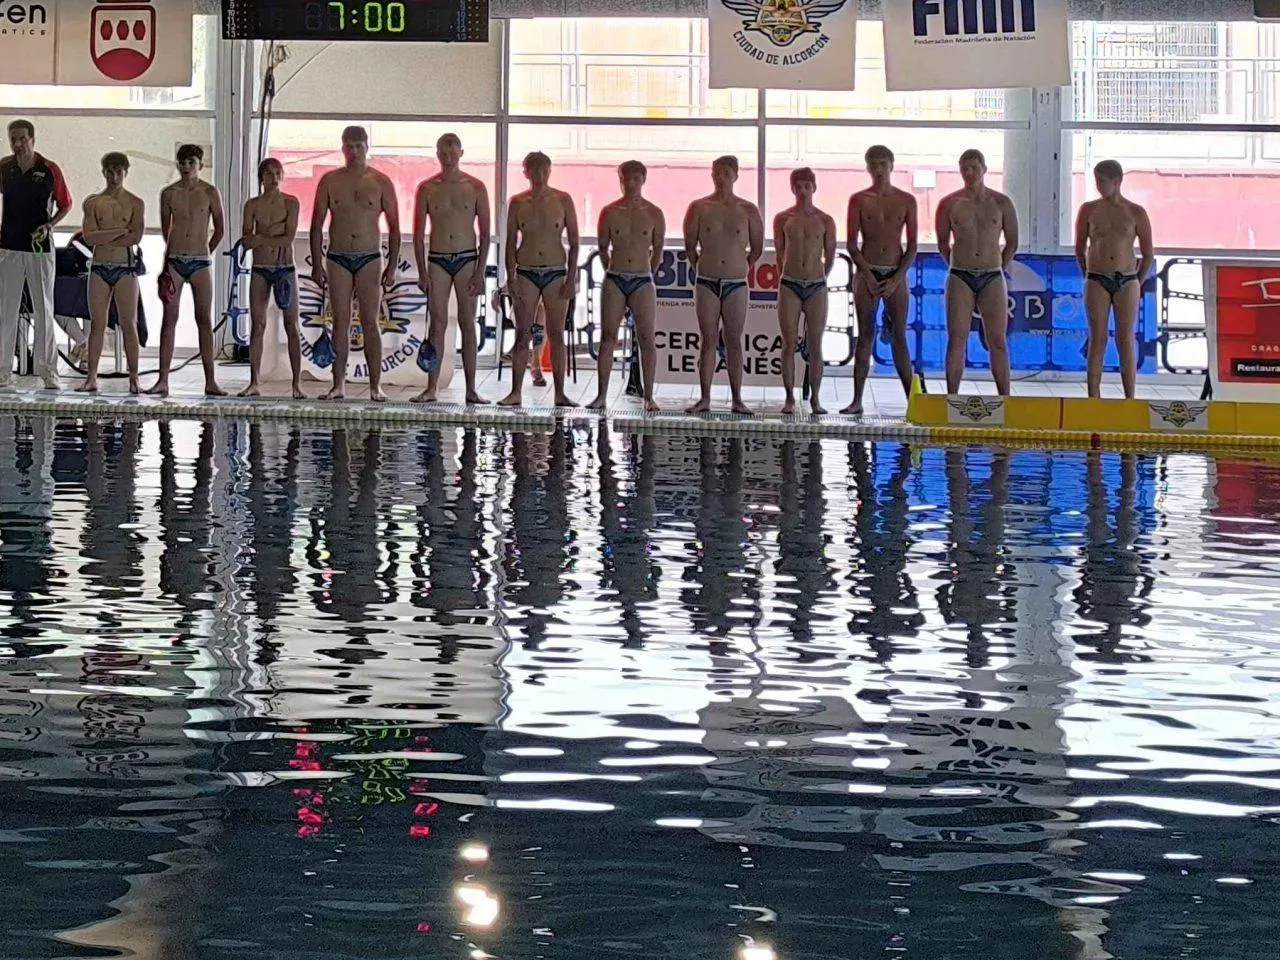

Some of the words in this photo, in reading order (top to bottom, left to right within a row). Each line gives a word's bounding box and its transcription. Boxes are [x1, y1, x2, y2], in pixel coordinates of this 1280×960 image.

[327, 1, 405, 32] 7:00
[733, 30, 765, 61] CIUDAD
[765, 53, 779, 65] DE
[782, 33, 831, 66] ALCORCÓN
